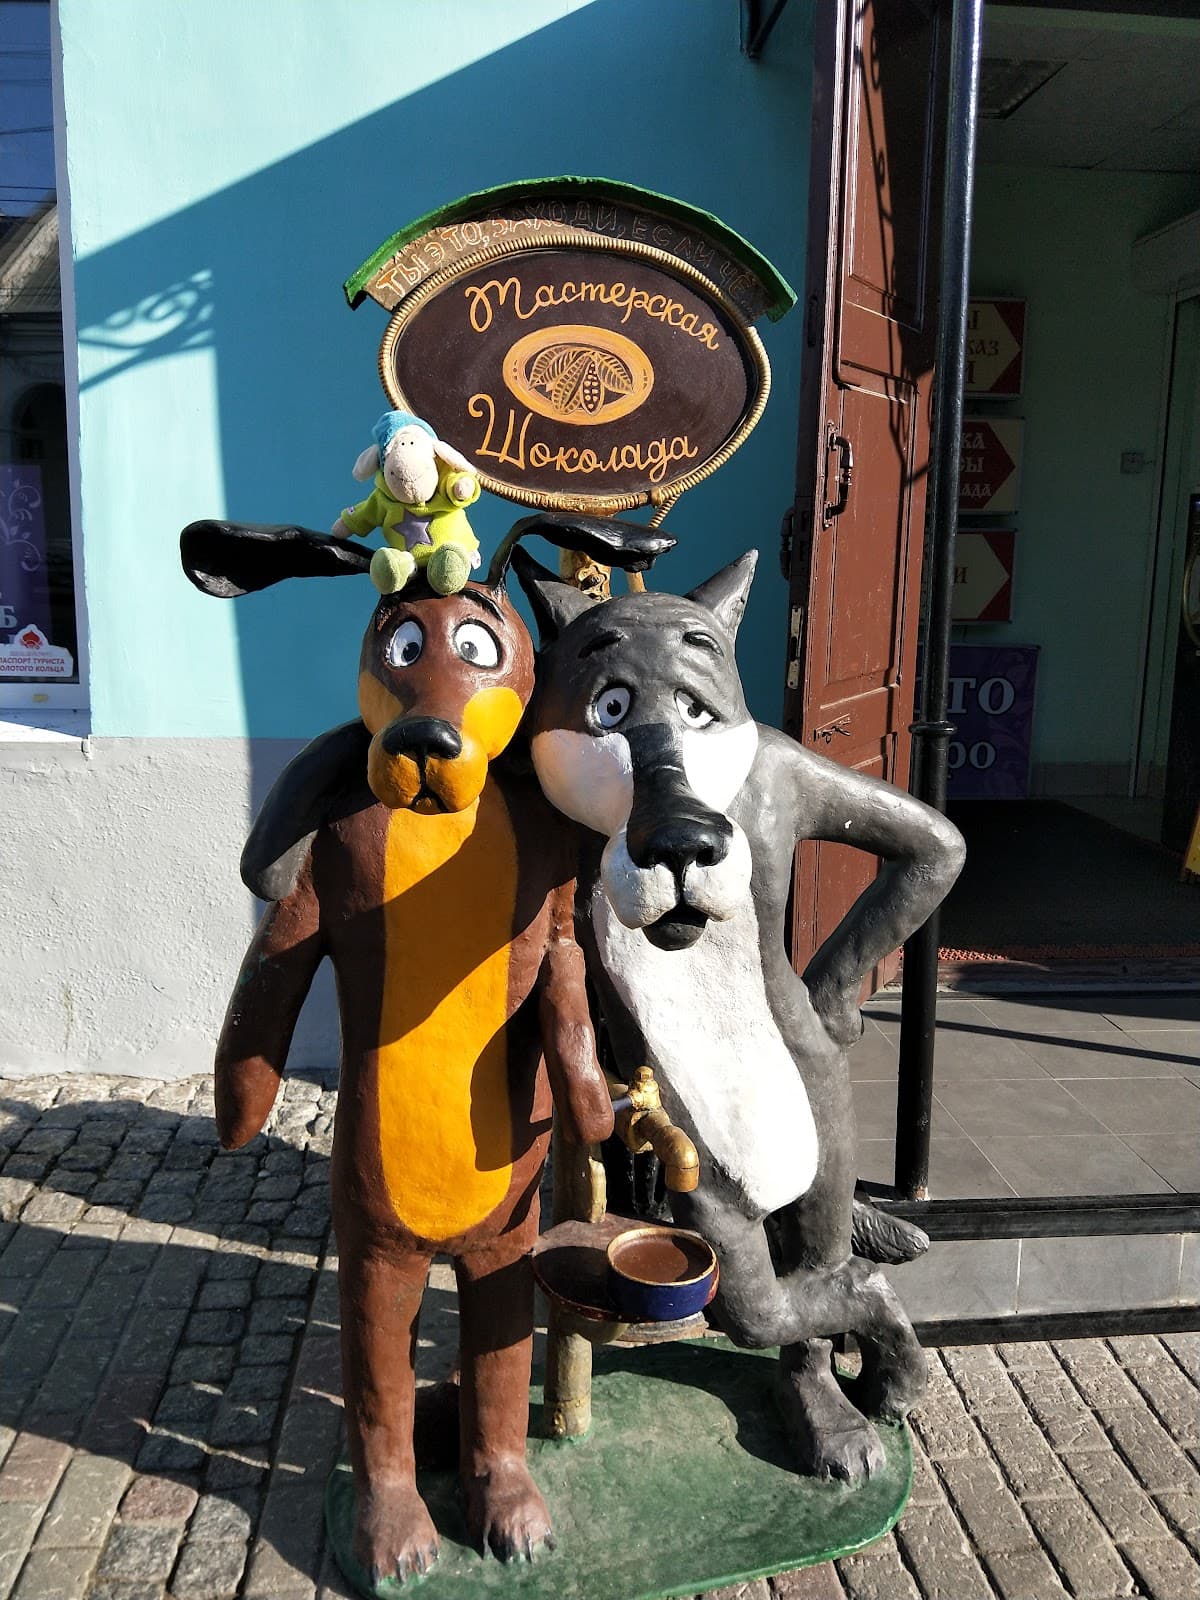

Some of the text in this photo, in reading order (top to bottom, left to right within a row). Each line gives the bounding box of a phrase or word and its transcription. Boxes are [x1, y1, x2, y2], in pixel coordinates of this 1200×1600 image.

[376, 254, 428, 299] ТЫ
[632, 215, 715, 268] ЕСЛИ
[465, 277, 719, 351] Мастерская
[467, 394, 699, 483] Шоколада
